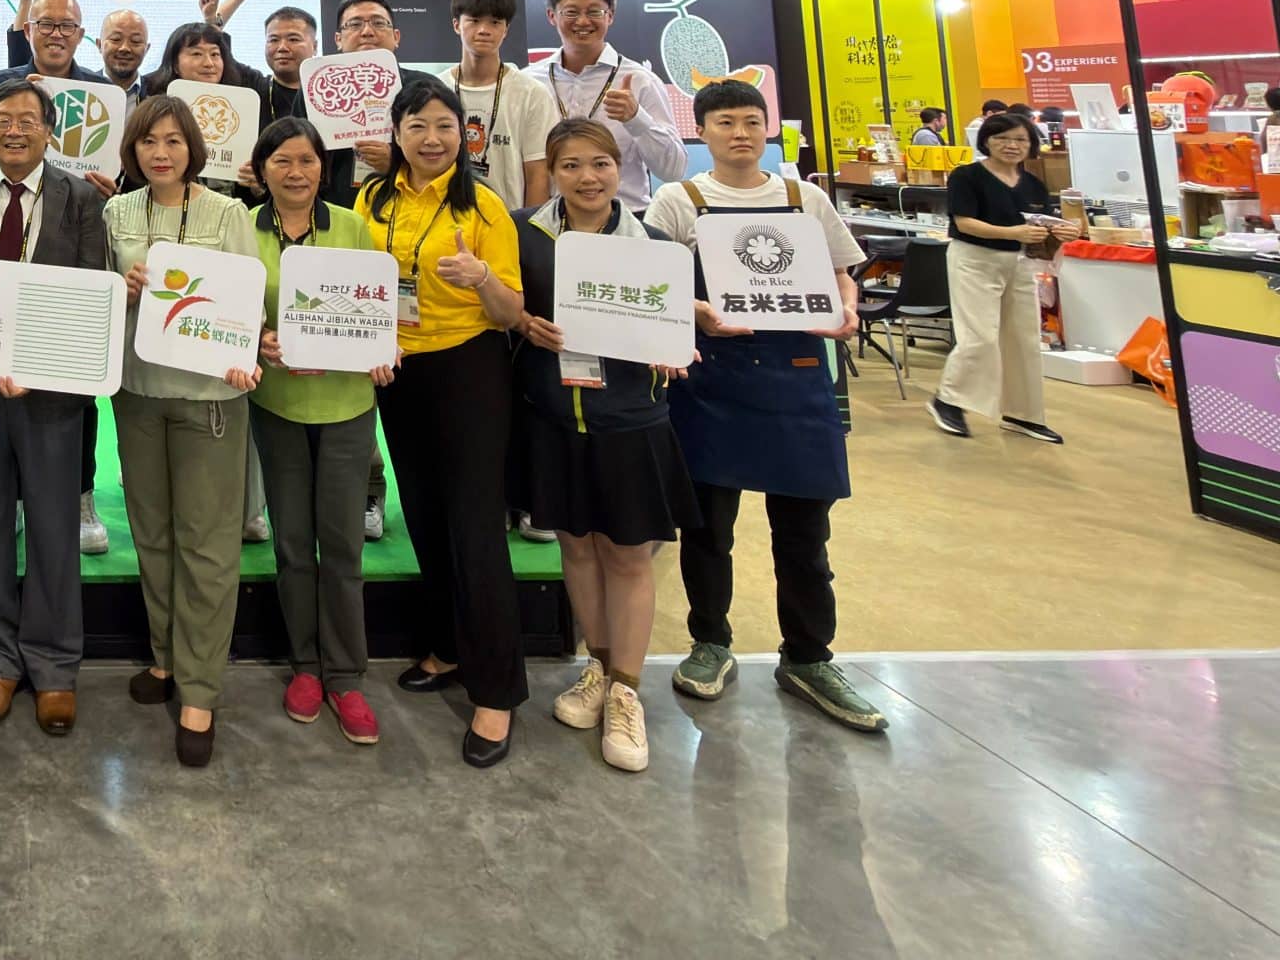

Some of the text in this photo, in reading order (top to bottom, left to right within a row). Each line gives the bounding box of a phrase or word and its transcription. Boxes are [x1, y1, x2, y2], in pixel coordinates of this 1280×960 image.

[1054, 56, 1119, 66] EXPERIENCE
[76, 162, 100, 171] ZHAN
[749, 276, 793, 287] the Rice
[320, 284, 350, 295] わさび
[720, 292, 834, 315] 友米友田
[284, 312, 393, 328] ALISHAN JIBIAN WASABI
